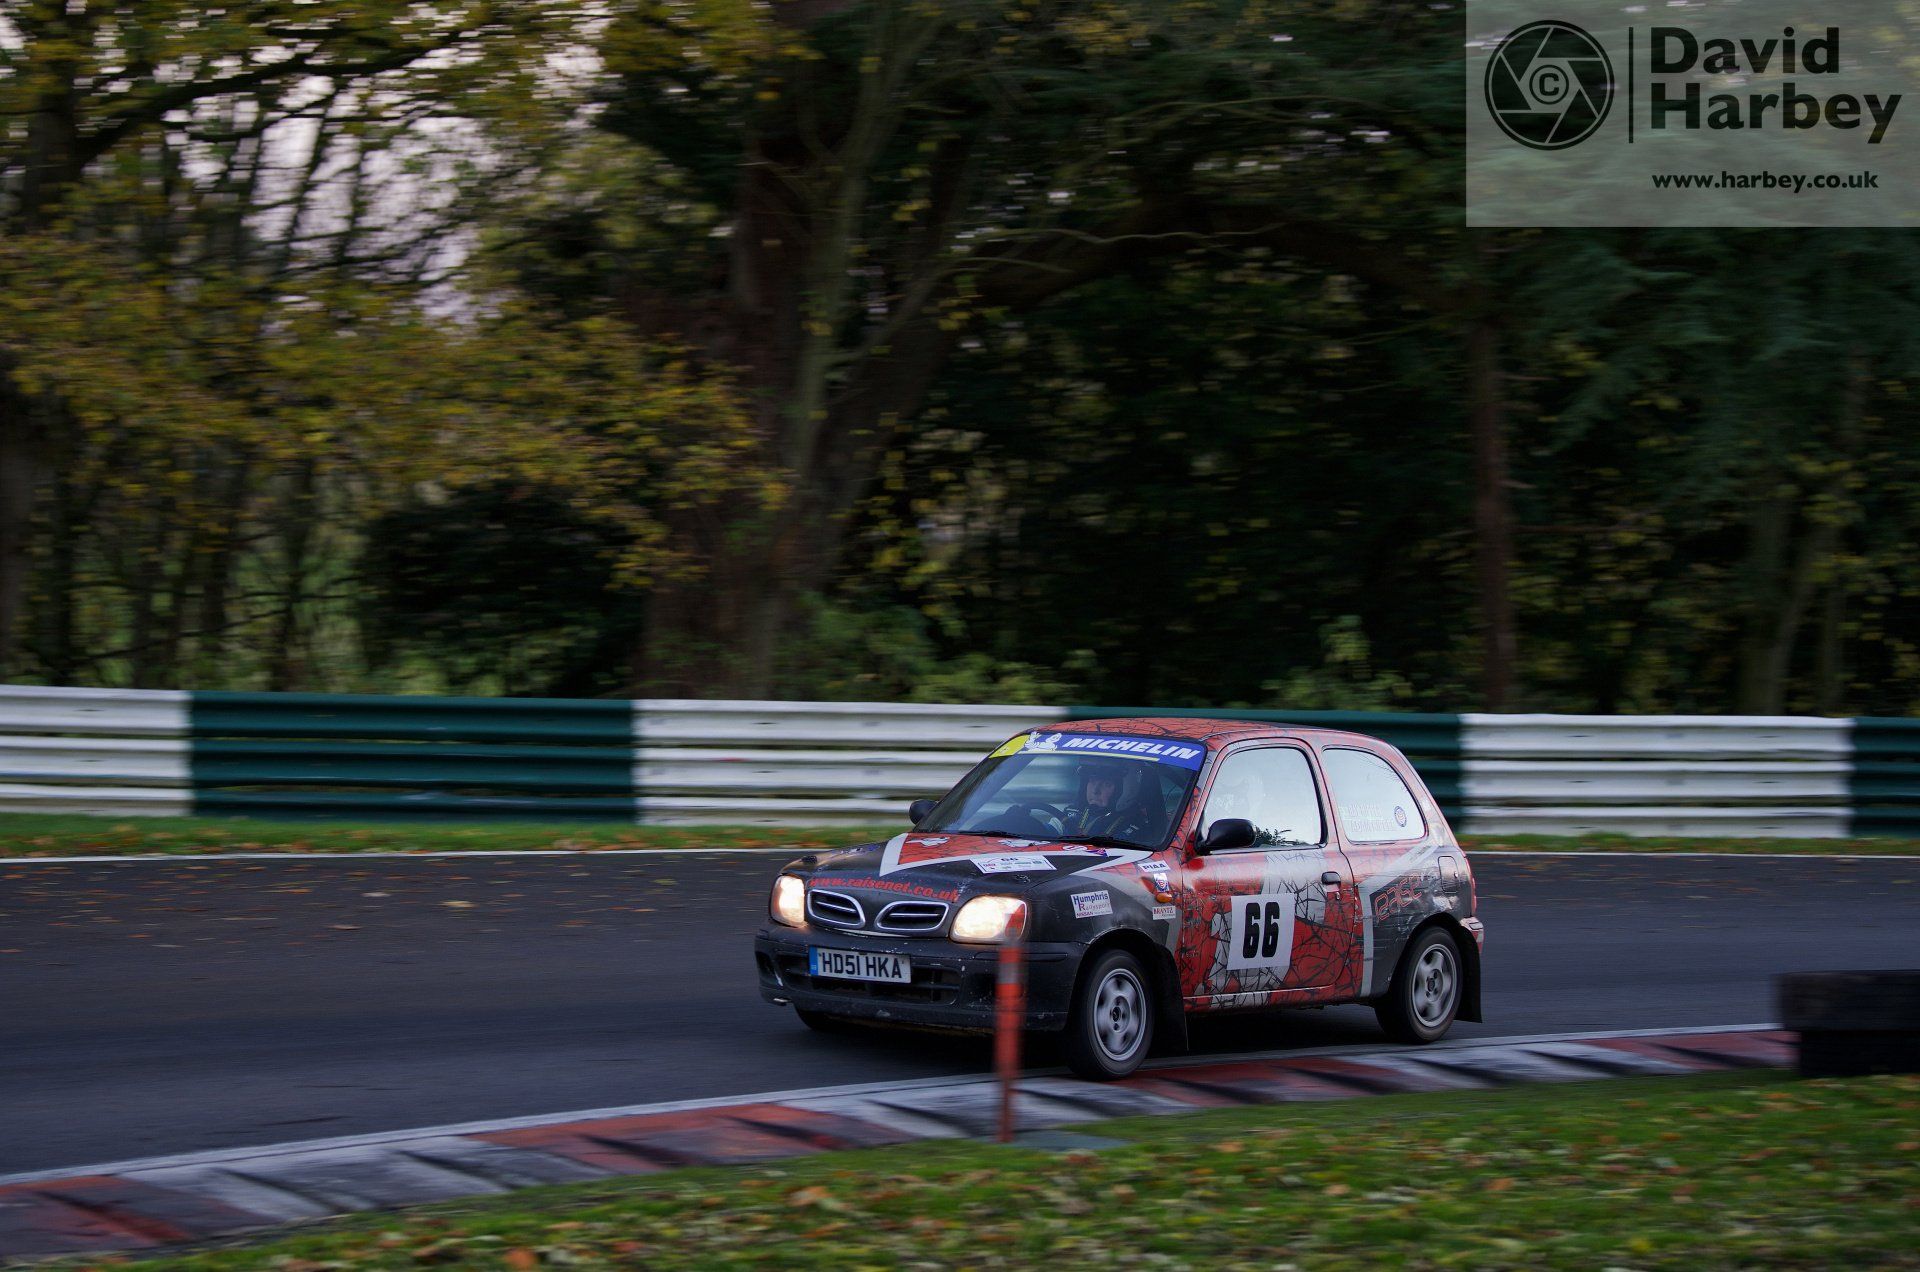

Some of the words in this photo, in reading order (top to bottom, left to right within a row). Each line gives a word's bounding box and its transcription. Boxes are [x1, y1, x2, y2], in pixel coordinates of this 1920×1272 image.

[1062, 737, 1201, 760] MICHELIN
[1072, 891, 1109, 905] Humphris
[1242, 902, 1280, 959] 66
[822, 952, 861, 976] HD51
[866, 956, 902, 979] HKA
